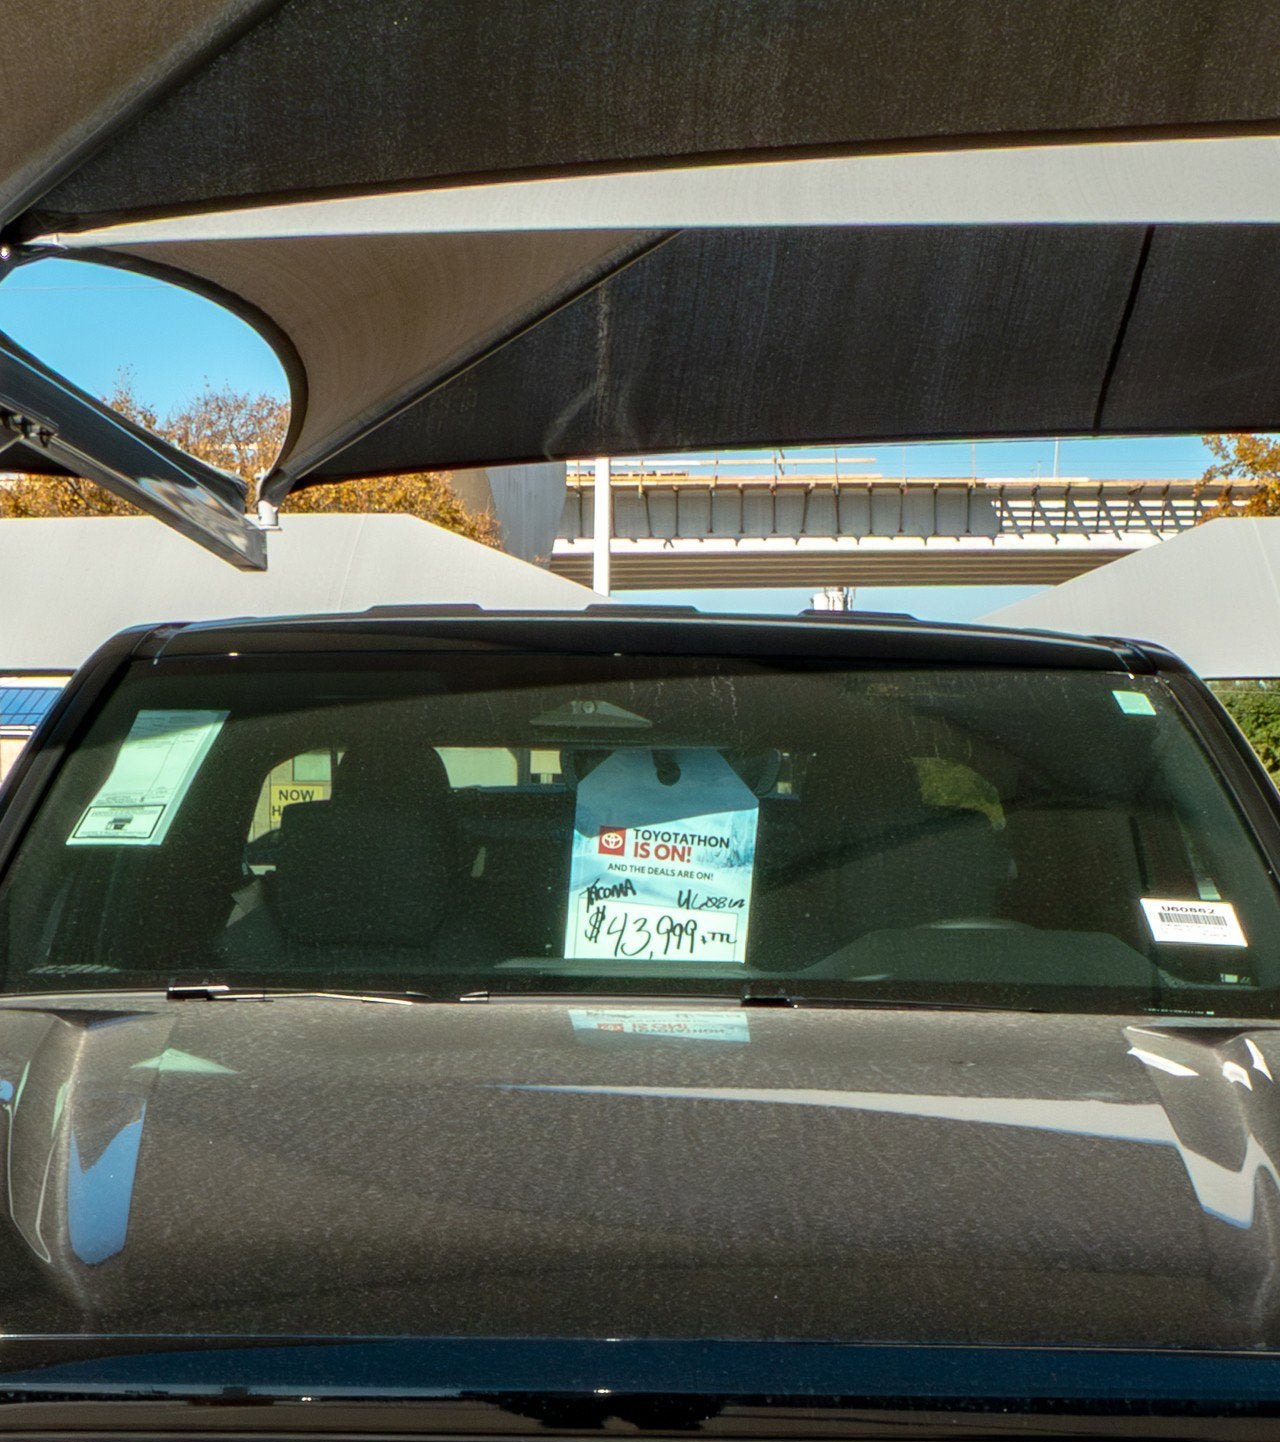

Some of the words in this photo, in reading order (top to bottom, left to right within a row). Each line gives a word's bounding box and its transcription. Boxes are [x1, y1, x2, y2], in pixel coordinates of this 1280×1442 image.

[279, 789, 315, 803] NOW
[633, 828, 730, 849] TOYOTATHON
[633, 841, 651, 859] IS
[654, 843, 693, 864] ON!
[607, 863, 628, 872] AND
[629, 864, 646, 874] THE
[647, 866, 676, 877] DEALS
[676, 870, 695, 879] ARE
[696, 871, 714, 881] ON!
